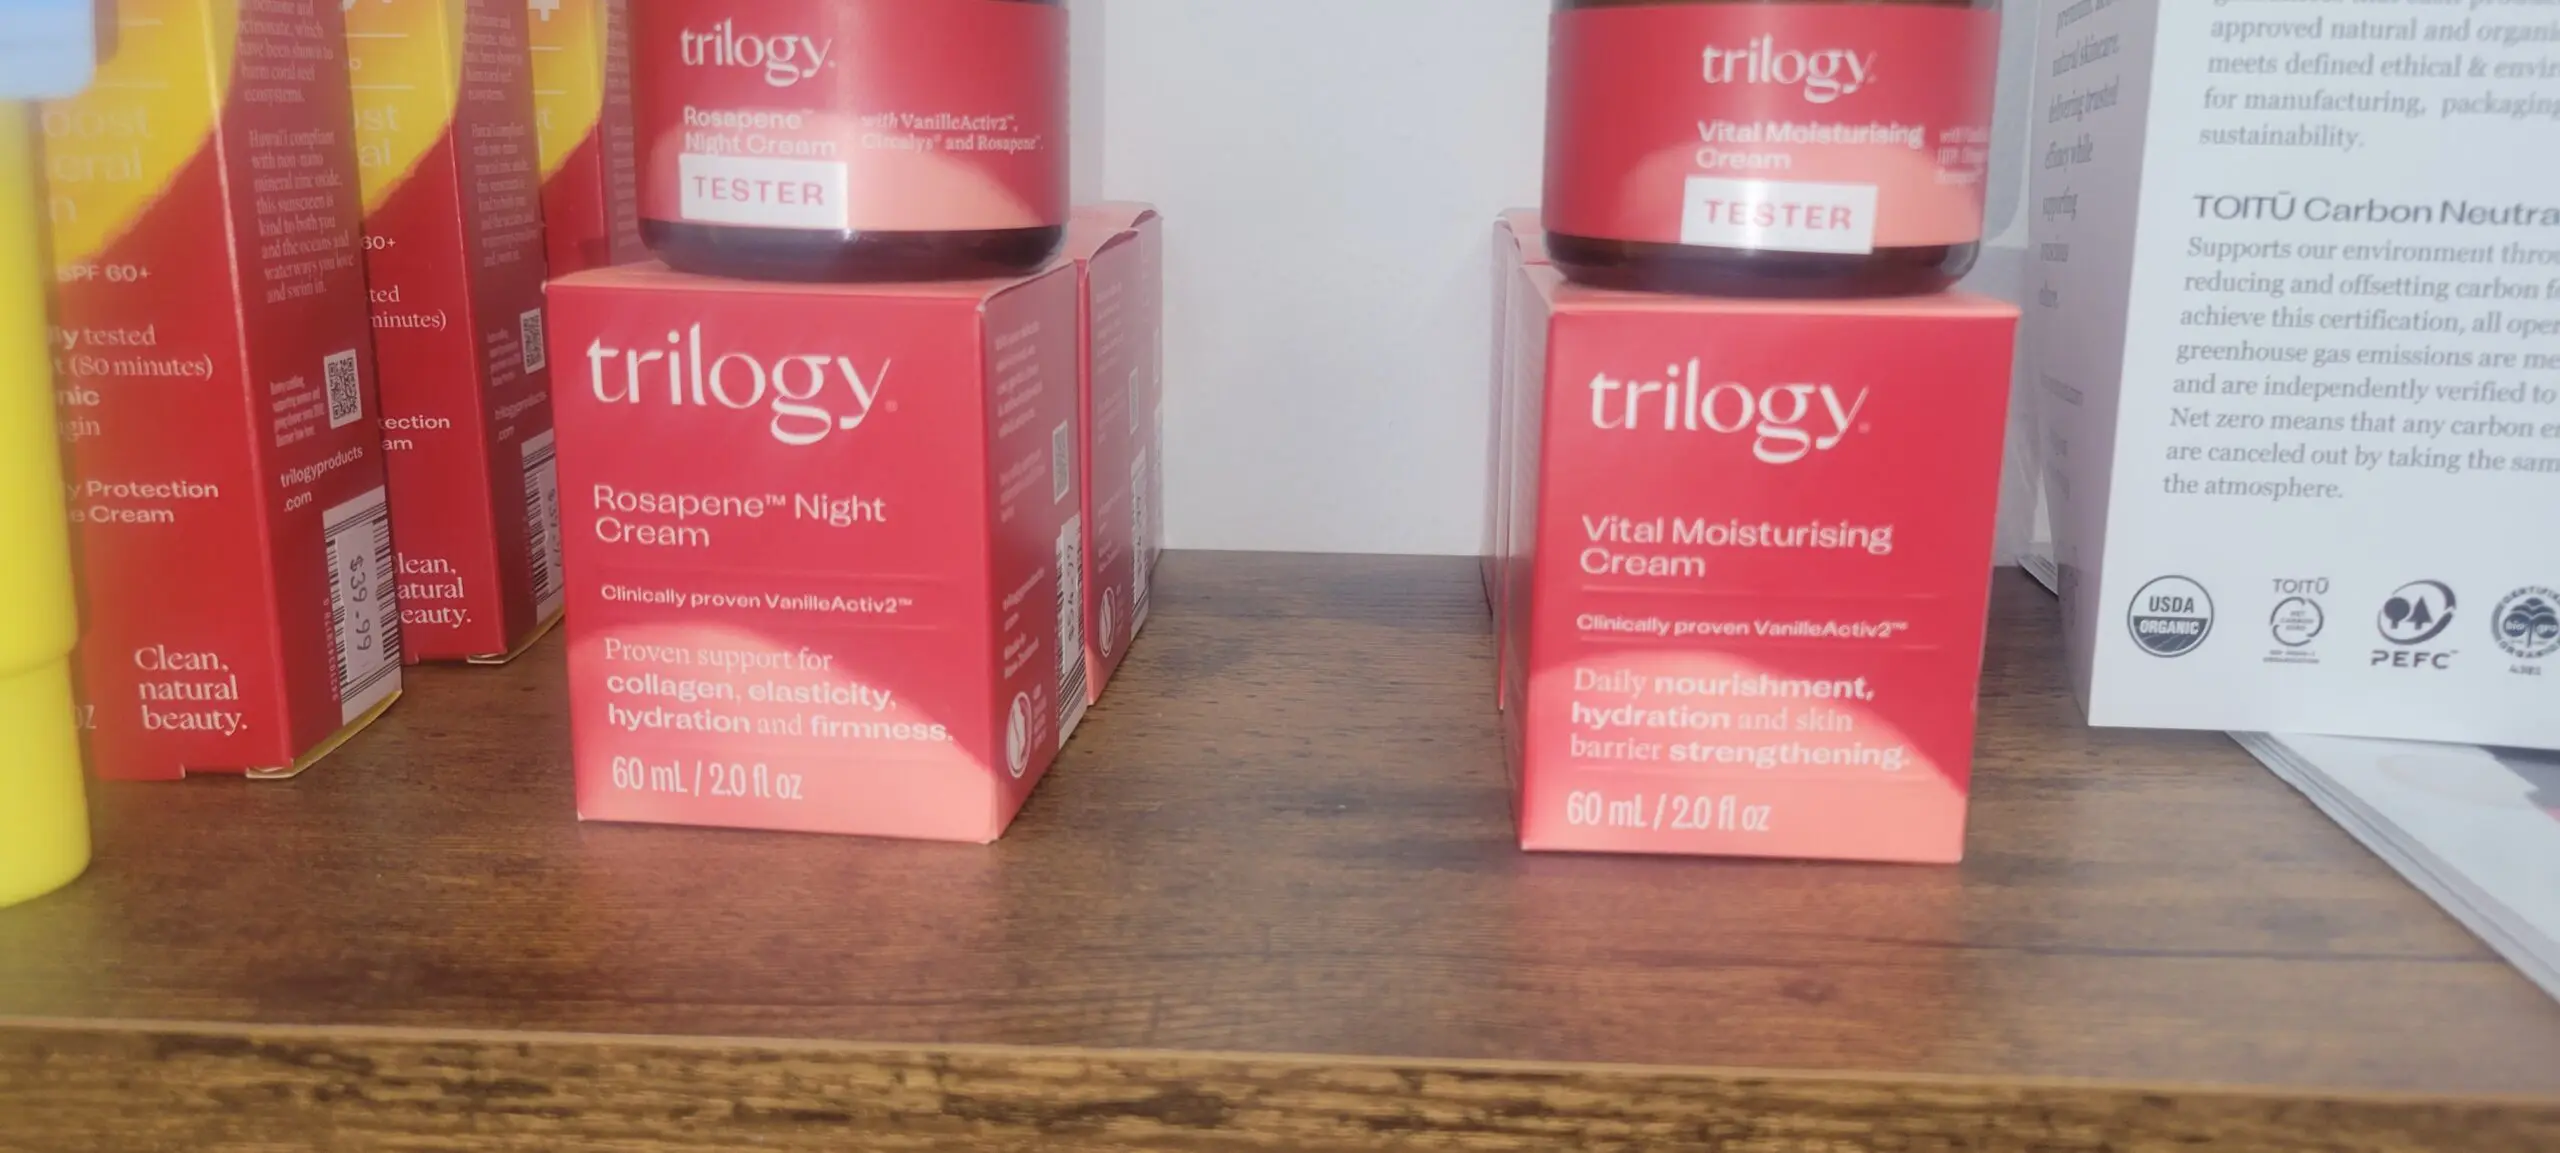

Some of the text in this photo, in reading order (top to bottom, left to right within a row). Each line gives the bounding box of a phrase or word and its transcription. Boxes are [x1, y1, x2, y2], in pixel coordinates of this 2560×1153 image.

[2211, 16, 2322, 43] approved
[2331, 17, 2417, 41] natural
[2424, 17, 2469, 42] and
[681, 17, 832, 87] trilogy
[2207, 55, 2277, 75] meets
[2285, 53, 2374, 76] defined
[2381, 53, 2461, 78] ethical
[2467, 55, 2487, 77] &
[1702, 33, 1875, 103] trilogy
[2203, 86, 2238, 110] for
[2244, 87, 2427, 118] manufacturing,
[747, 134, 836, 156] Cream
[945, 135, 974, 150] and
[1697, 120, 1925, 150] Vital Moisturising
[2199, 123, 2365, 152] sustainability.
[1696, 149, 1791, 170] Cream
[692, 176, 823, 205] TESTER
[1704, 199, 1853, 231] TESTER
[2193, 191, 2296, 221] TOITŪ
[2304, 197, 2432, 224] Carbon
[2187, 237, 2494, 264] Supports our environment
[105, 264, 152, 282] 60+
[2183, 271, 2285, 298] reducing
[2291, 273, 2333, 294] and
[2339, 274, 2450, 302] offsetting
[2455, 276, 2540, 299] carbon
[84, 324, 156, 345] tested
[2180, 306, 2502, 336] achieve this certification, all
[70, 355, 109, 377] (80
[114, 354, 213, 381] minutes)
[2175, 340, 2517, 368] greenhouse gas emissions are
[586, 322, 891, 445] trilogy
[2172, 374, 2558, 405] and are independently verified to
[1589, 356, 1869, 464] trilogy
[2169, 407, 2210, 428] Net
[2216, 411, 2264, 430] zero
[2270, 414, 2345, 432] means
[2350, 411, 2396, 433] that
[2402, 418, 2445, 440] any
[2450, 415, 2534, 438] carbon
[280, 446, 363, 488] trilogyproducts
[2165, 443, 2506, 474] are canceled out by taking the
[86, 480, 219, 498] Protection
[284, 491, 313, 512] .com
[2163, 473, 2344, 501] the atmosphere.
[90, 505, 174, 523] Cream
[794, 492, 886, 527] Night
[595, 517, 709, 547] Cream
[1582, 515, 1893, 555] Vital Moisturising
[393, 552, 456, 575] lean,
[1580, 548, 1706, 577] Cream
[601, 584, 686, 608] Clinically
[691, 591, 760, 609] proven
[2148, 595, 2194, 615] USDA
[1577, 614, 1671, 636] Clinically
[1674, 620, 1750, 637] proven
[2139, 618, 2199, 636] ORGANIC
[605, 637, 833, 674] Proven support for
[138, 674, 238, 701] natural
[607, 674, 896, 711] collagen, elasticity,
[1574, 668, 1874, 702] Daily nourishment,
[141, 704, 248, 736] beauty.
[609, 704, 953, 741] hydration and firmness.
[1572, 702, 1853, 732] hydration and skin
[1570, 734, 1911, 772] barrier strengthening.
[612, 756, 803, 800] 60 mL / 2.0 fl oz
[1567, 790, 1772, 832] 60 mL / 2.0 fl oz
